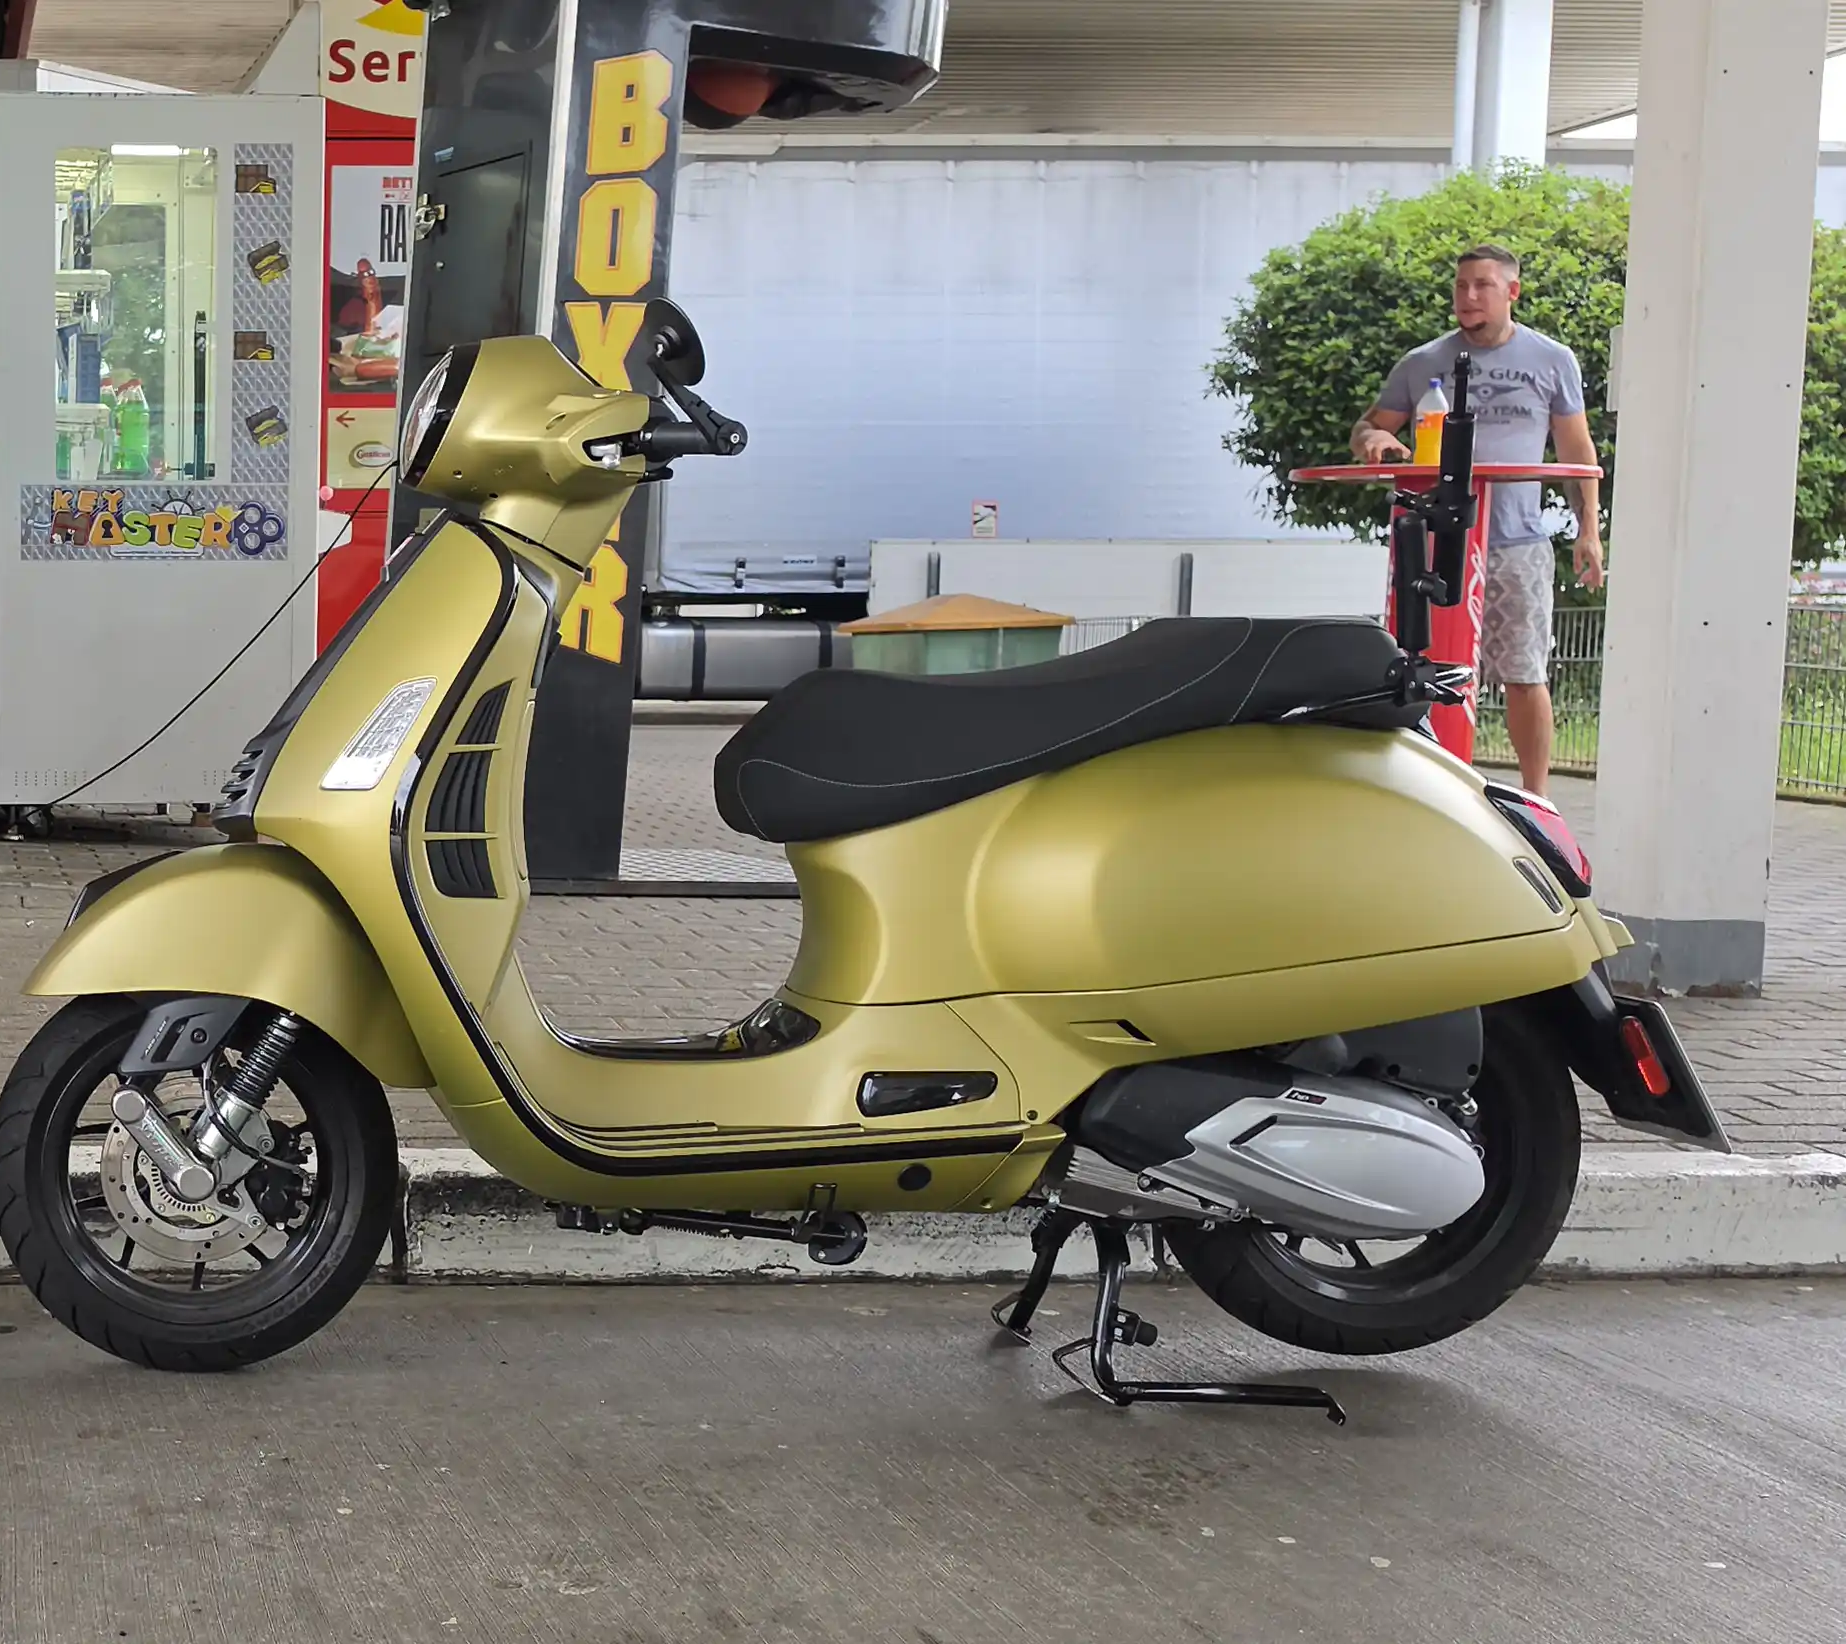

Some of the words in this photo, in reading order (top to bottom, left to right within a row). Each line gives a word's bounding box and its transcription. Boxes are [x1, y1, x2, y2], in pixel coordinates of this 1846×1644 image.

[328, 38, 422, 83] Ser
[380, 204, 412, 262] RA
[560, 49, 674, 665] BOXR
[1438, 361, 1482, 384] TP
[1489, 369, 1535, 383] GUN
[1492, 405, 1532, 417] TEAM
[53, 488, 125, 513] KEY
[50, 509, 230, 549] MASTER
